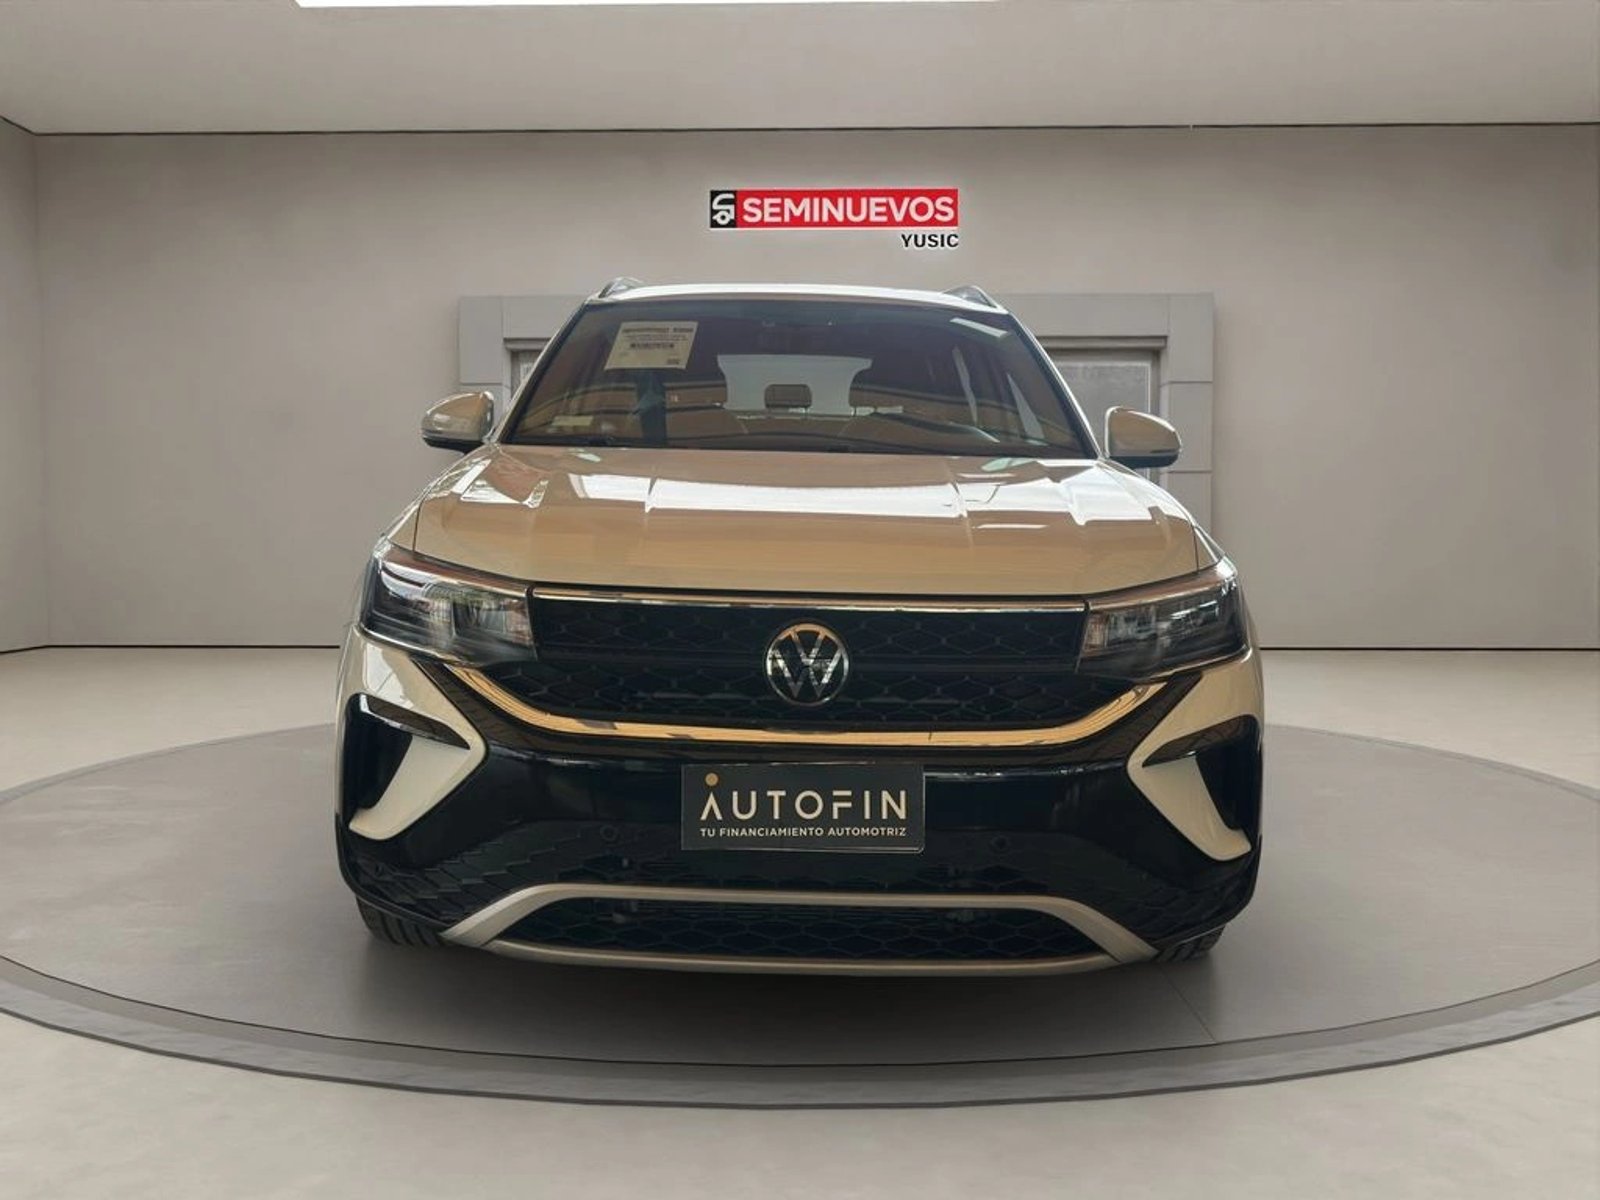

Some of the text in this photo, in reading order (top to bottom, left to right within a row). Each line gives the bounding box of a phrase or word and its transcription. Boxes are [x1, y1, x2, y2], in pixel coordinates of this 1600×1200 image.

[742, 196, 955, 223] SEMINUEVOS
[901, 233, 959, 248] YUSIC
[700, 789, 906, 820] AUTOFIN
[700, 827, 906, 837] TU FINANCIAMIENTO AUTOMOTRIZ
